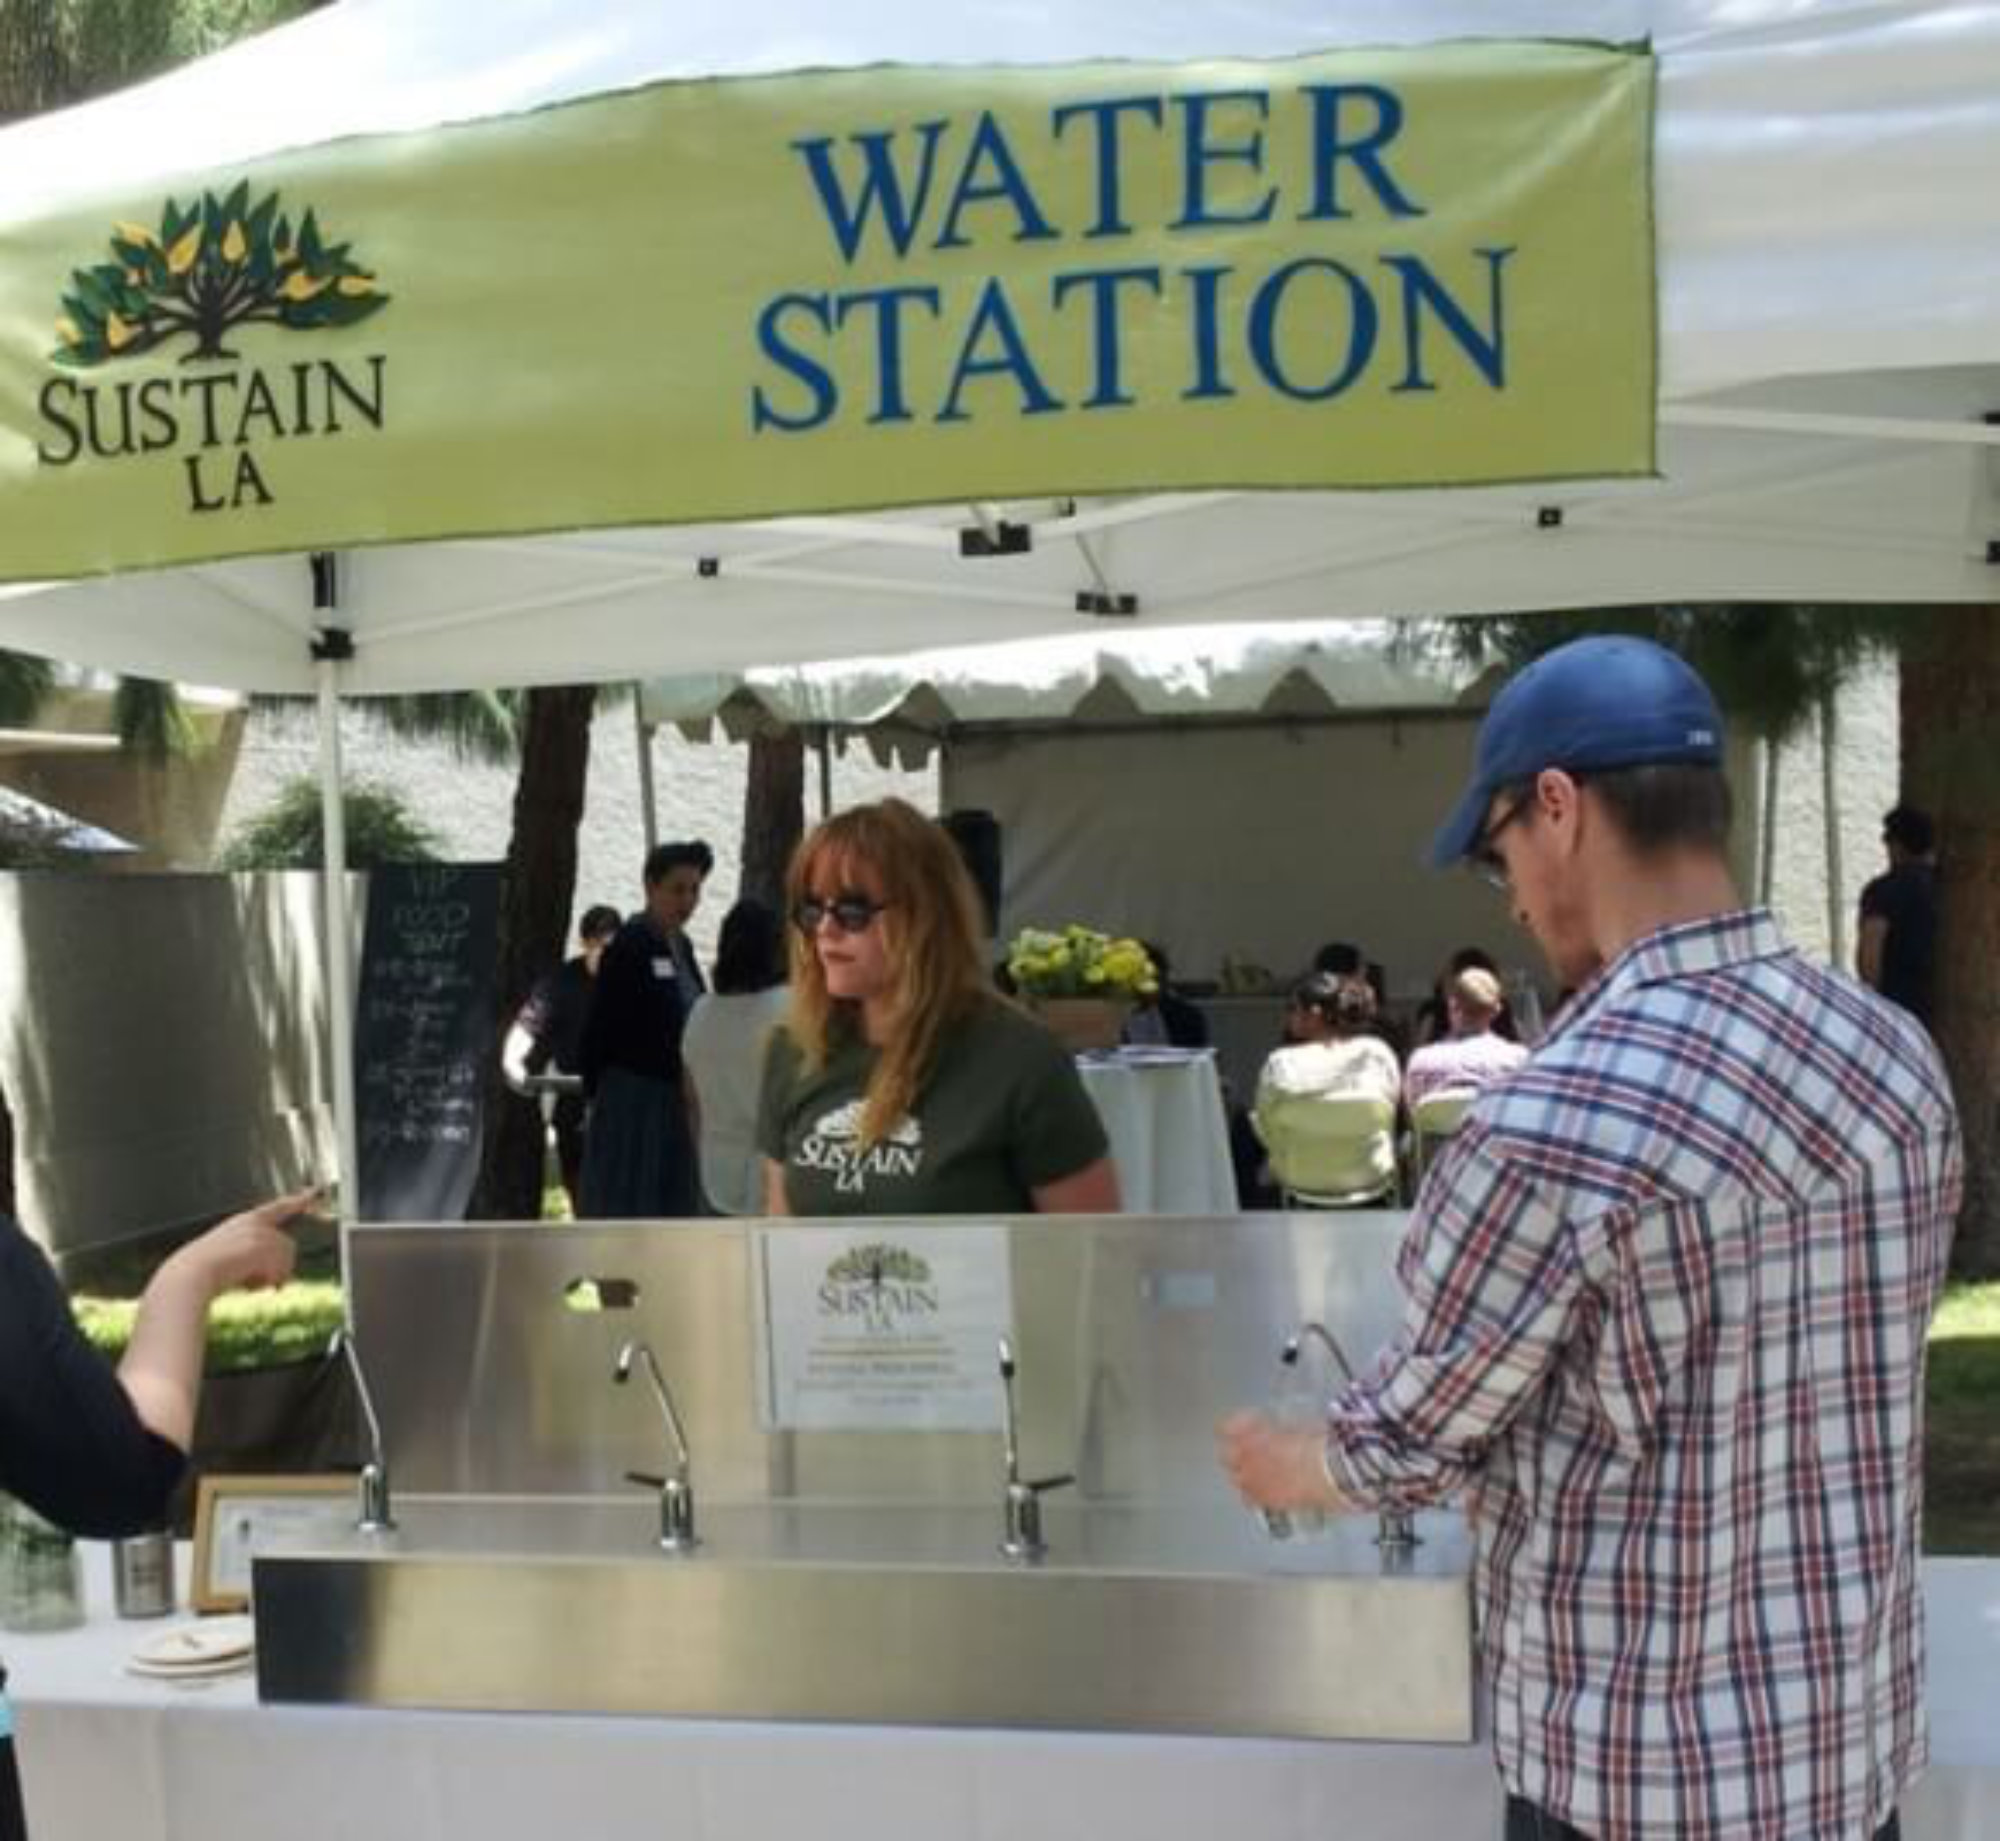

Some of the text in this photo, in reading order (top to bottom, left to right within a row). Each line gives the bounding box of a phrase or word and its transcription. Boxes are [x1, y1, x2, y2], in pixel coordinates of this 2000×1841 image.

[789, 83, 1429, 265] WATER
[751, 245, 1518, 434] STATION
[38, 354, 387, 467] SUSTAIN
[183, 450, 275, 513] LA
[794, 1133, 921, 1175] SUSTAIN
[834, 1170, 864, 1192] LA
